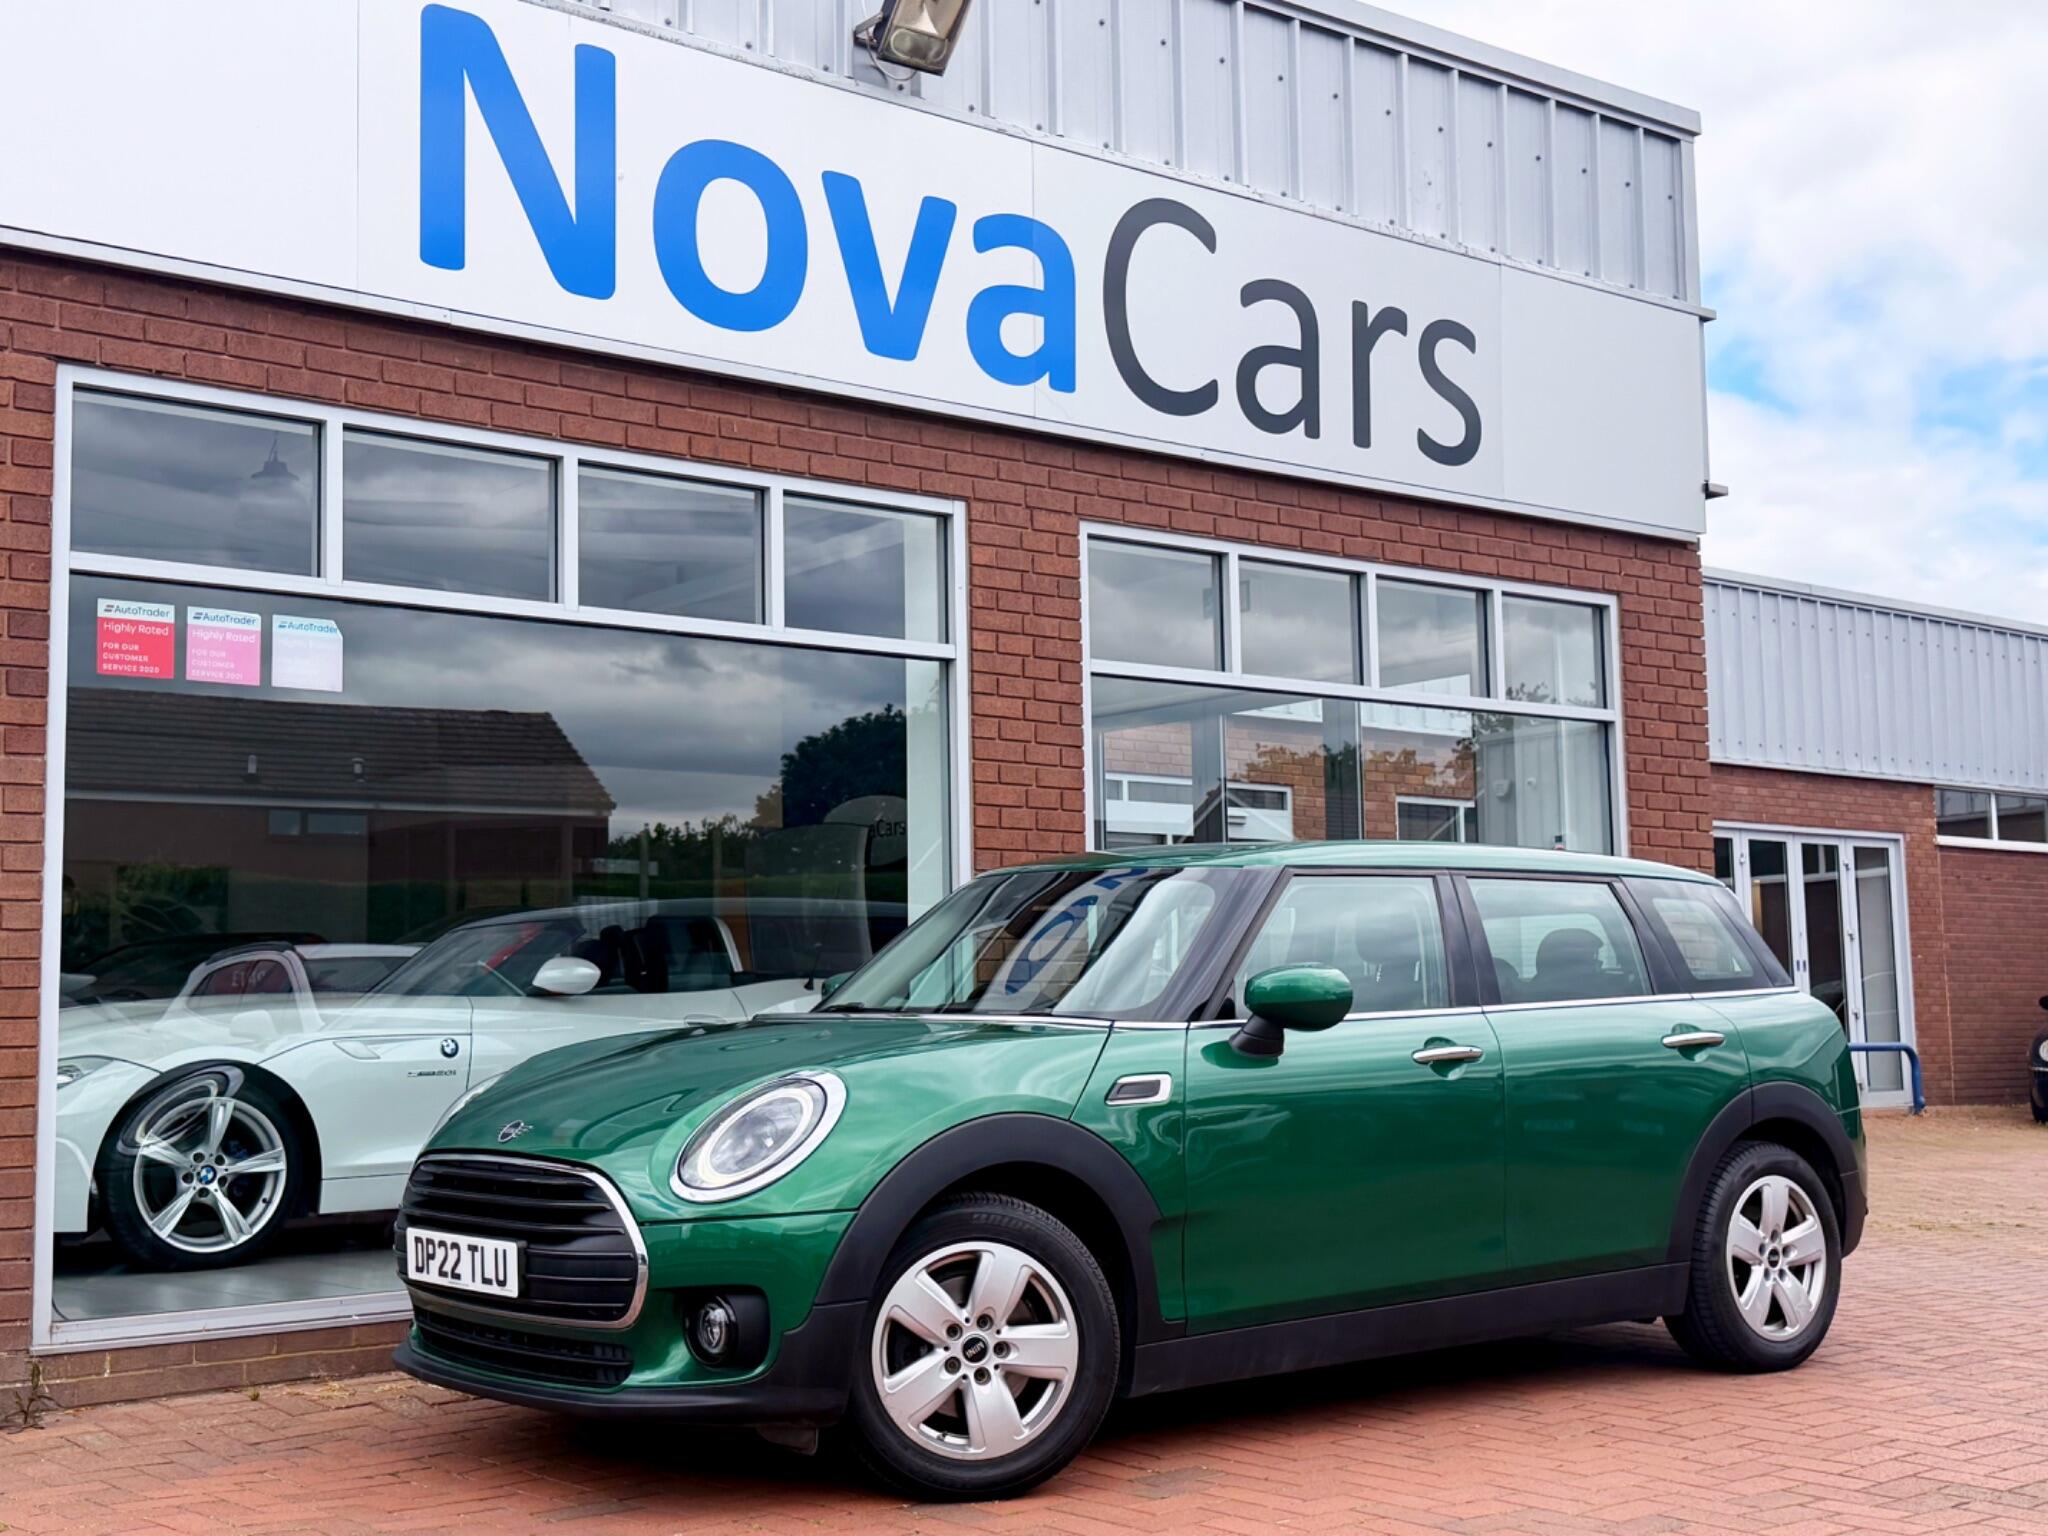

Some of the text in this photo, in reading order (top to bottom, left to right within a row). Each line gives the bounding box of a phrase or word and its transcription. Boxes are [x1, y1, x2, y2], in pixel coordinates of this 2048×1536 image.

[420, 3, 1482, 466] NovaCars
[115, 605, 171, 617] AutoTrader
[203, 612, 257, 625] AutoTrader
[103, 621, 169, 636] Highly Rated
[192, 629, 256, 643] Highly Rated
[102, 642, 140, 651] FOR OUR
[102, 652, 149, 662] CUSTOMER
[102, 663, 138, 673] SERVICE
[414, 1236, 507, 1288] DP22 TLU
